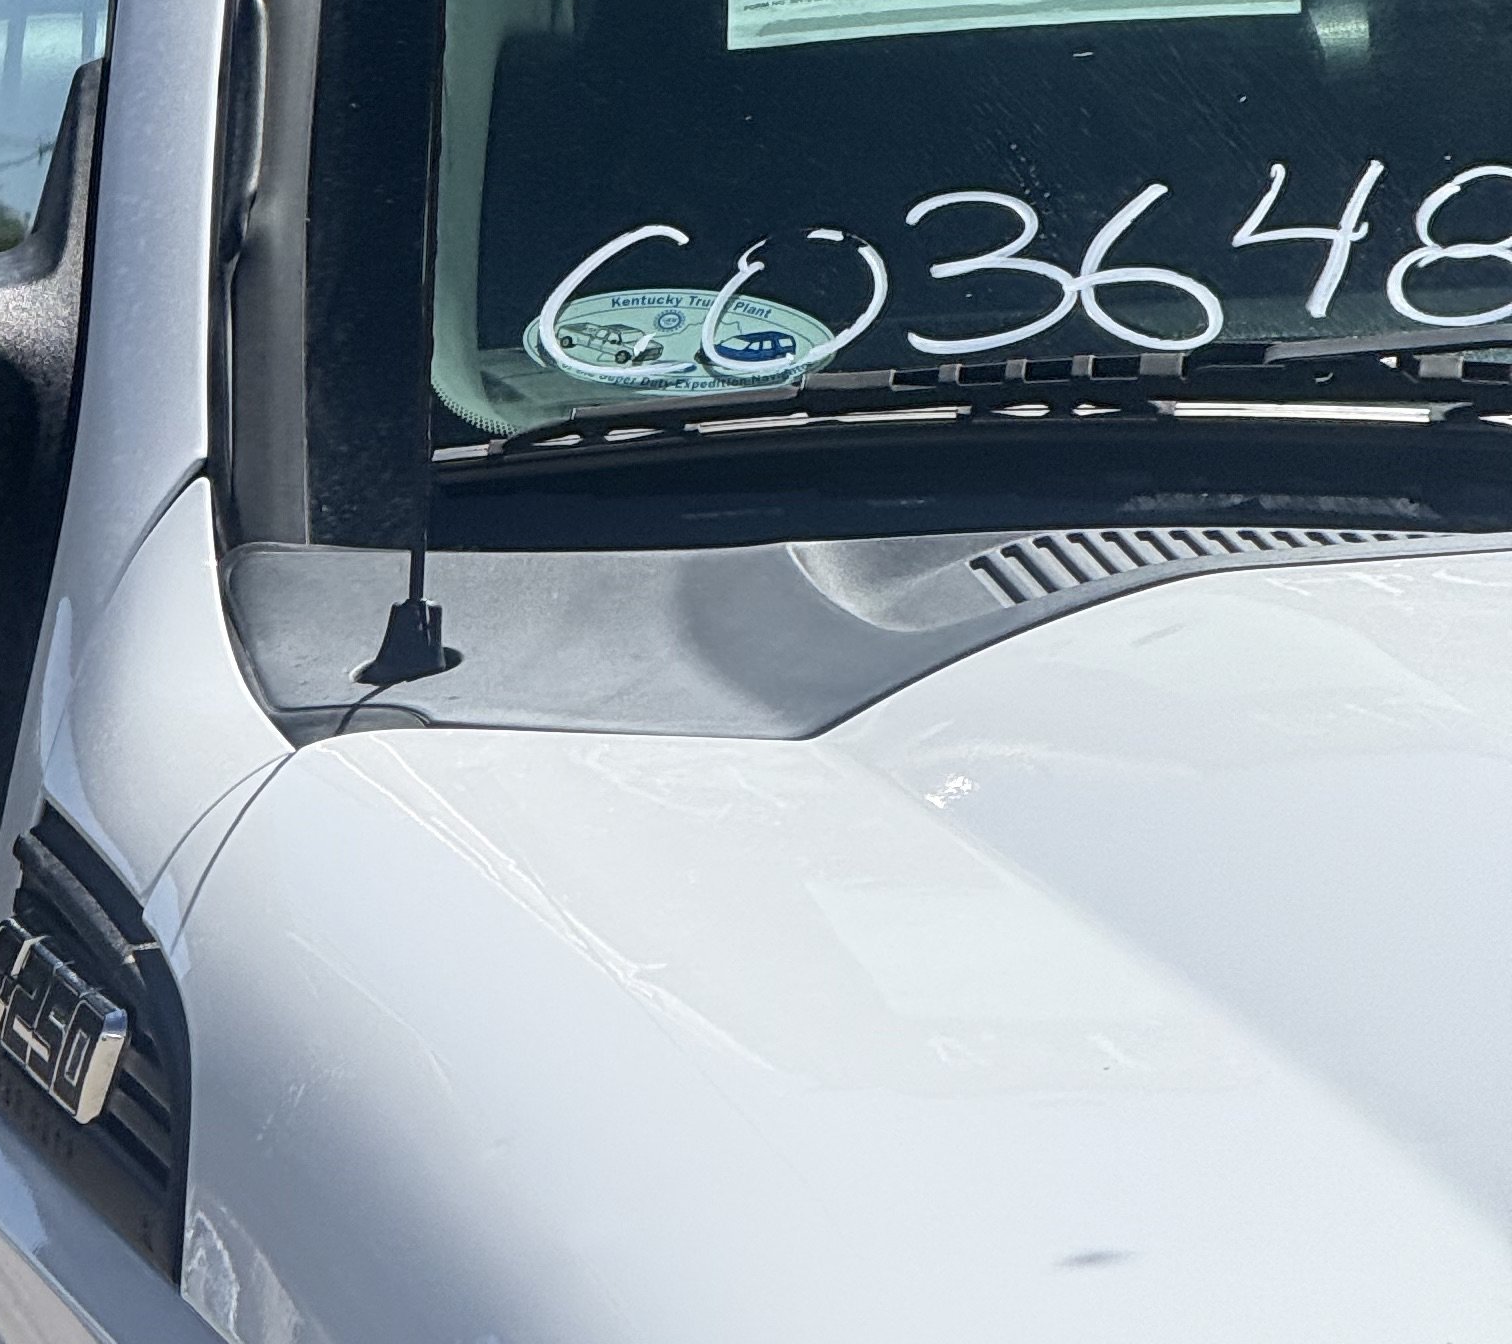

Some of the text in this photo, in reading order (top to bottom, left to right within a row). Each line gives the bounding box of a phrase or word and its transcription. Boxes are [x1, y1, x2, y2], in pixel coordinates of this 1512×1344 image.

[610, 294, 772, 319] Kentucky Tru Plant
